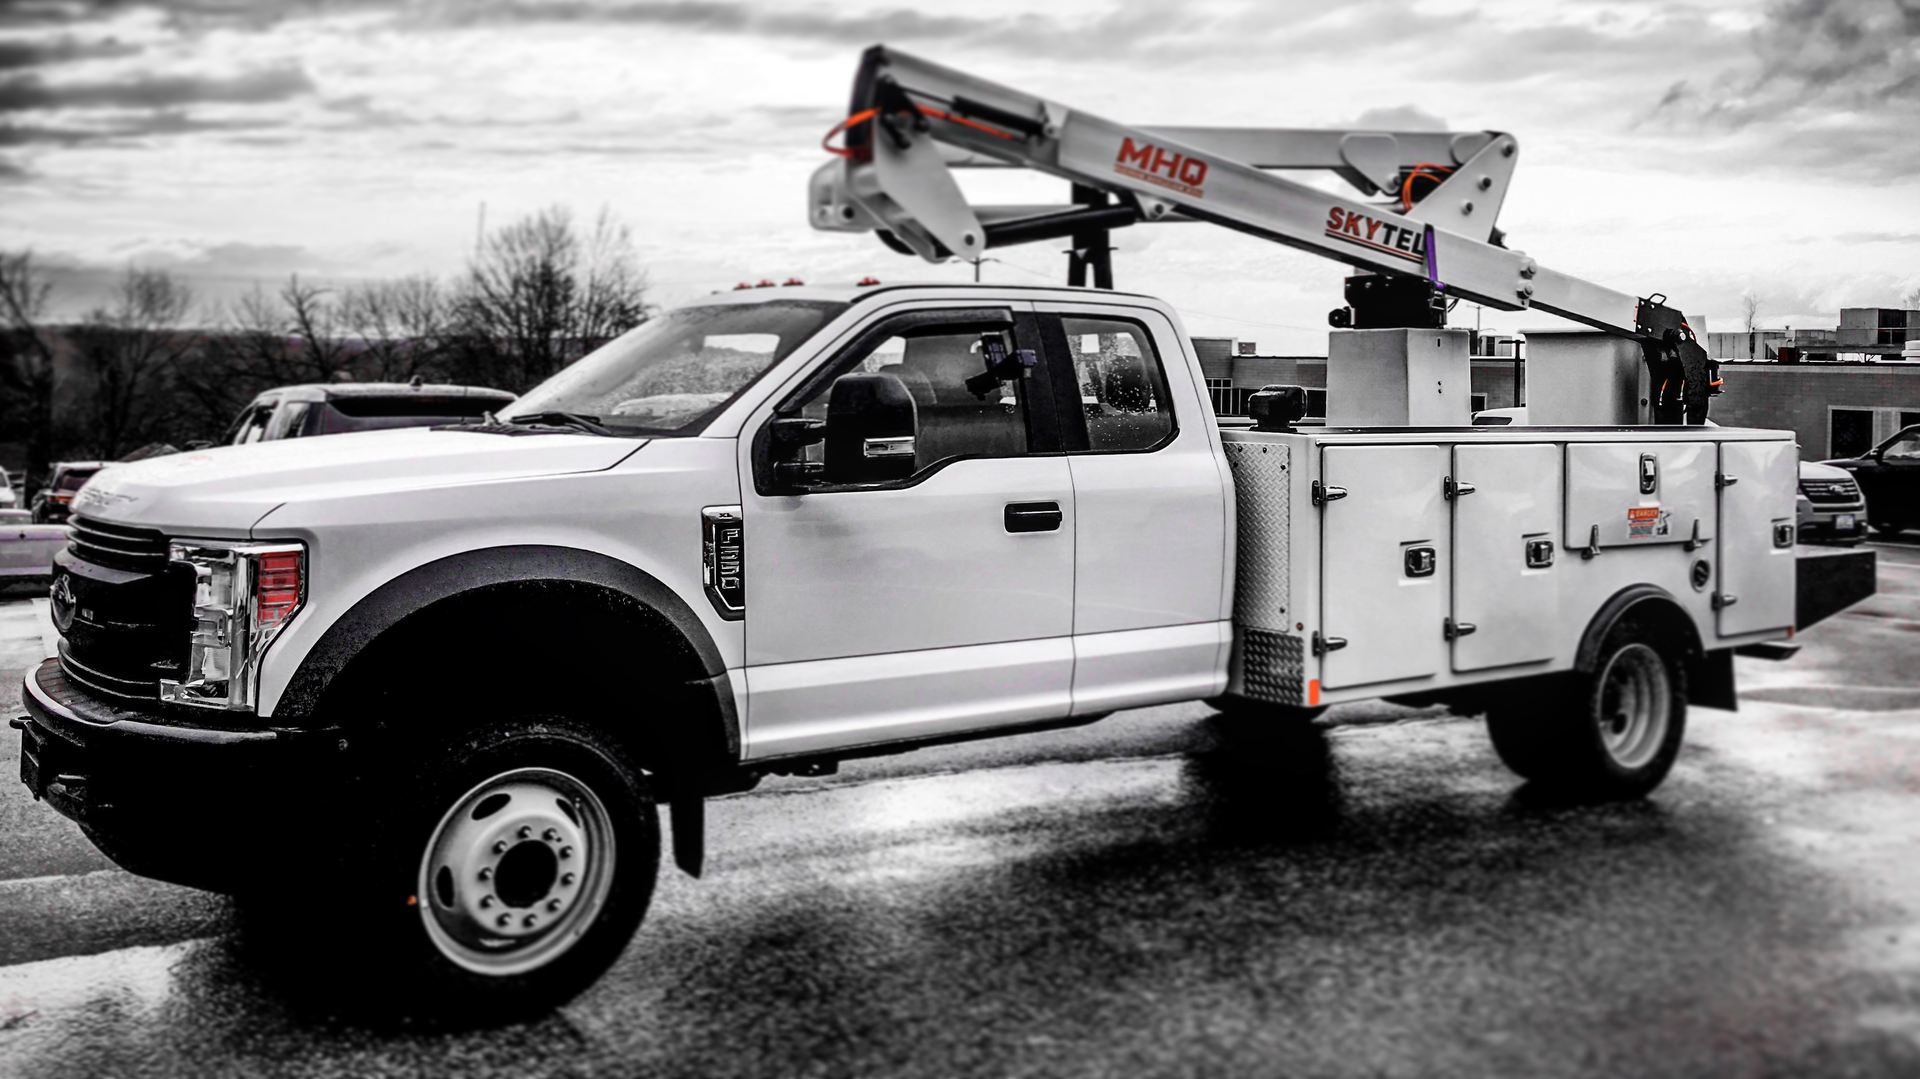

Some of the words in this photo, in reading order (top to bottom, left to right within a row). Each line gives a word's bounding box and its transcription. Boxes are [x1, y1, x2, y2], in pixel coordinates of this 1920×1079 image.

[1117, 137, 1208, 188] MHQ
[1326, 206, 1425, 256] SKYTEL
[720, 528, 740, 590] F550
